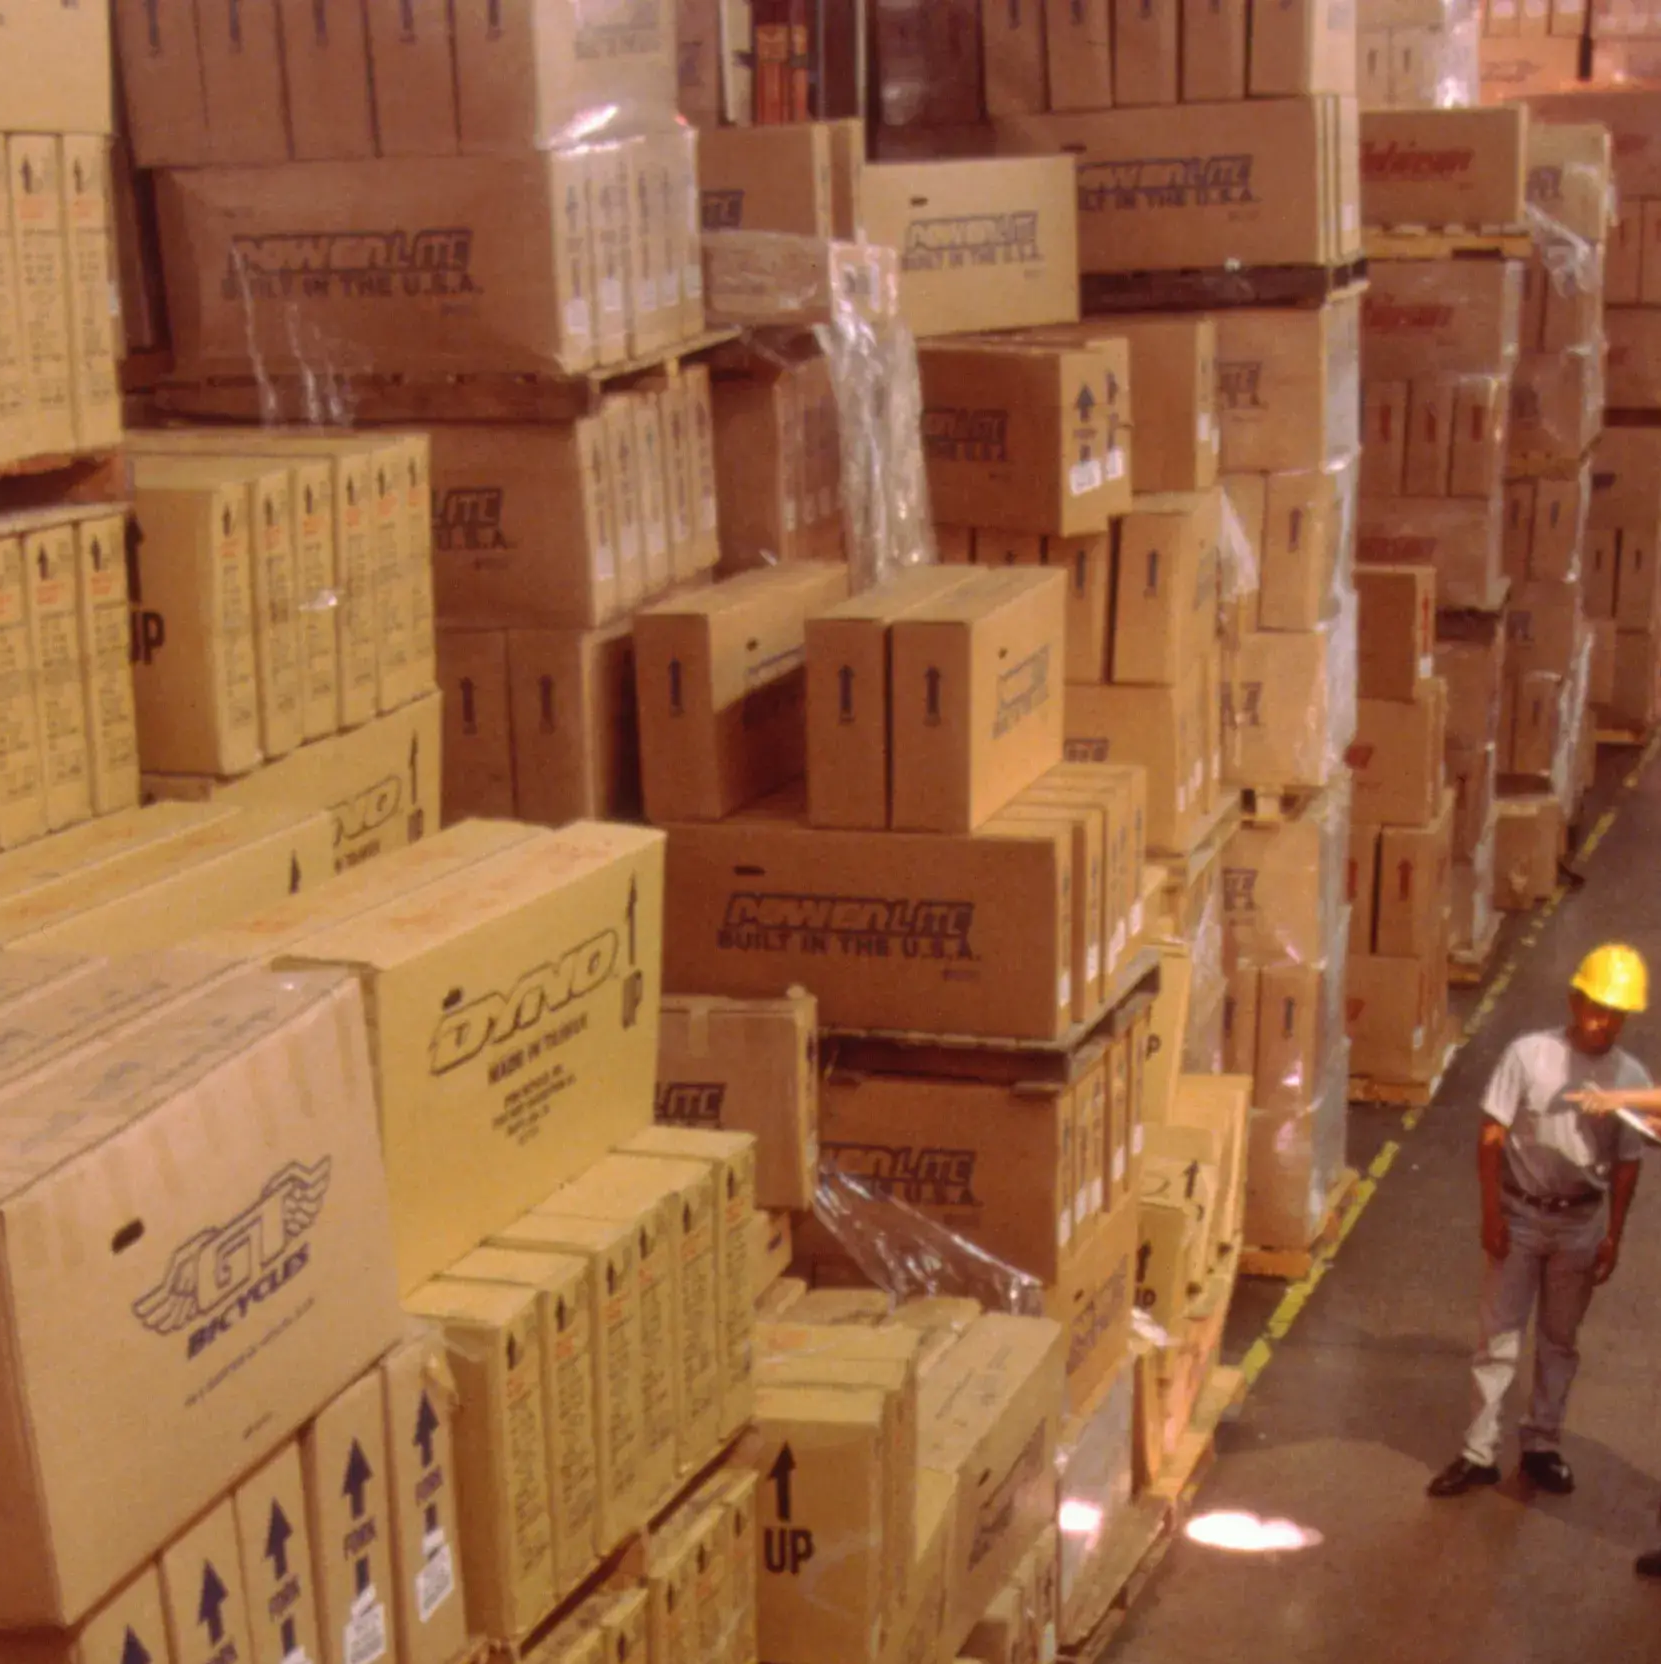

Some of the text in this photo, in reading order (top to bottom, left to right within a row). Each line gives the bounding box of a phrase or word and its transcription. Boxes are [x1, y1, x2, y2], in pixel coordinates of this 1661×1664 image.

[716, 928, 789, 953] BUILT
[800, 931, 828, 953] IN
[838, 935, 892, 958] THE
[429, 928, 619, 1077] DYNO
[764, 1528, 815, 1574] UP
